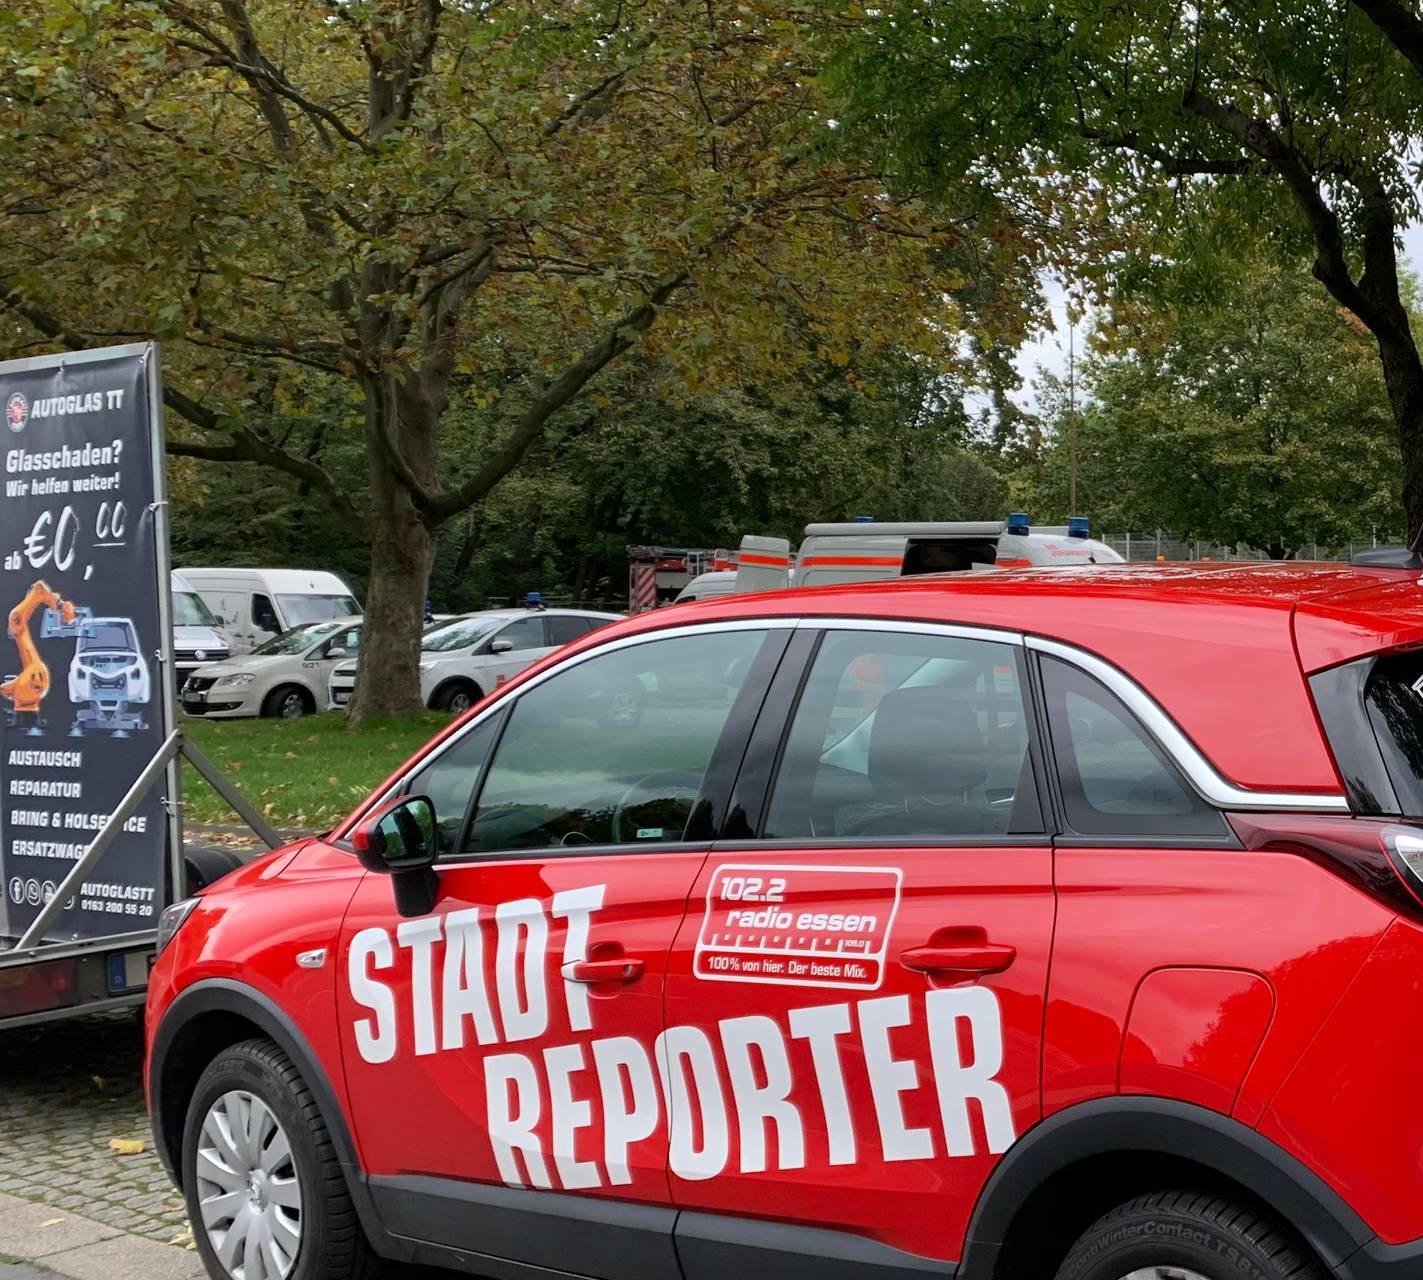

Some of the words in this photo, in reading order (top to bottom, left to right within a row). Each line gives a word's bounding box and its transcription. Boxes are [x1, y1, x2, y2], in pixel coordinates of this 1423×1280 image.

[31, 391, 102, 419] AUTOGLAS
[106, 389, 125, 410] TT
[6, 439, 123, 473] Glasschaden?
[6, 479, 28, 497] Wir
[31, 475, 69, 496] helfen
[73, 472, 121, 494] weiter!
[4, 551, 21, 571] ab
[8, 749, 83, 768] AUSTAUSCH
[9, 780, 82, 799] REPARATUR
[10, 810, 50, 827] BRING
[52, 812, 61, 828] &
[80, 882, 155, 901] AUTOGLASTT
[720, 877, 786, 902] 102.2
[81, 899, 104, 912] 0163
[105, 901, 123, 914] 200
[138, 904, 153, 917] 20
[725, 906, 793, 930] radio
[796, 911, 877, 933] essen
[347, 883, 607, 1065] STADT
[742, 959, 760, 973] von
[762, 957, 785, 975] hier.
[788, 962, 808, 976] Der
[810, 962, 841, 978] beste
[843, 963, 867, 979] Mix.
[482, 984, 1018, 1193] REPORTER
